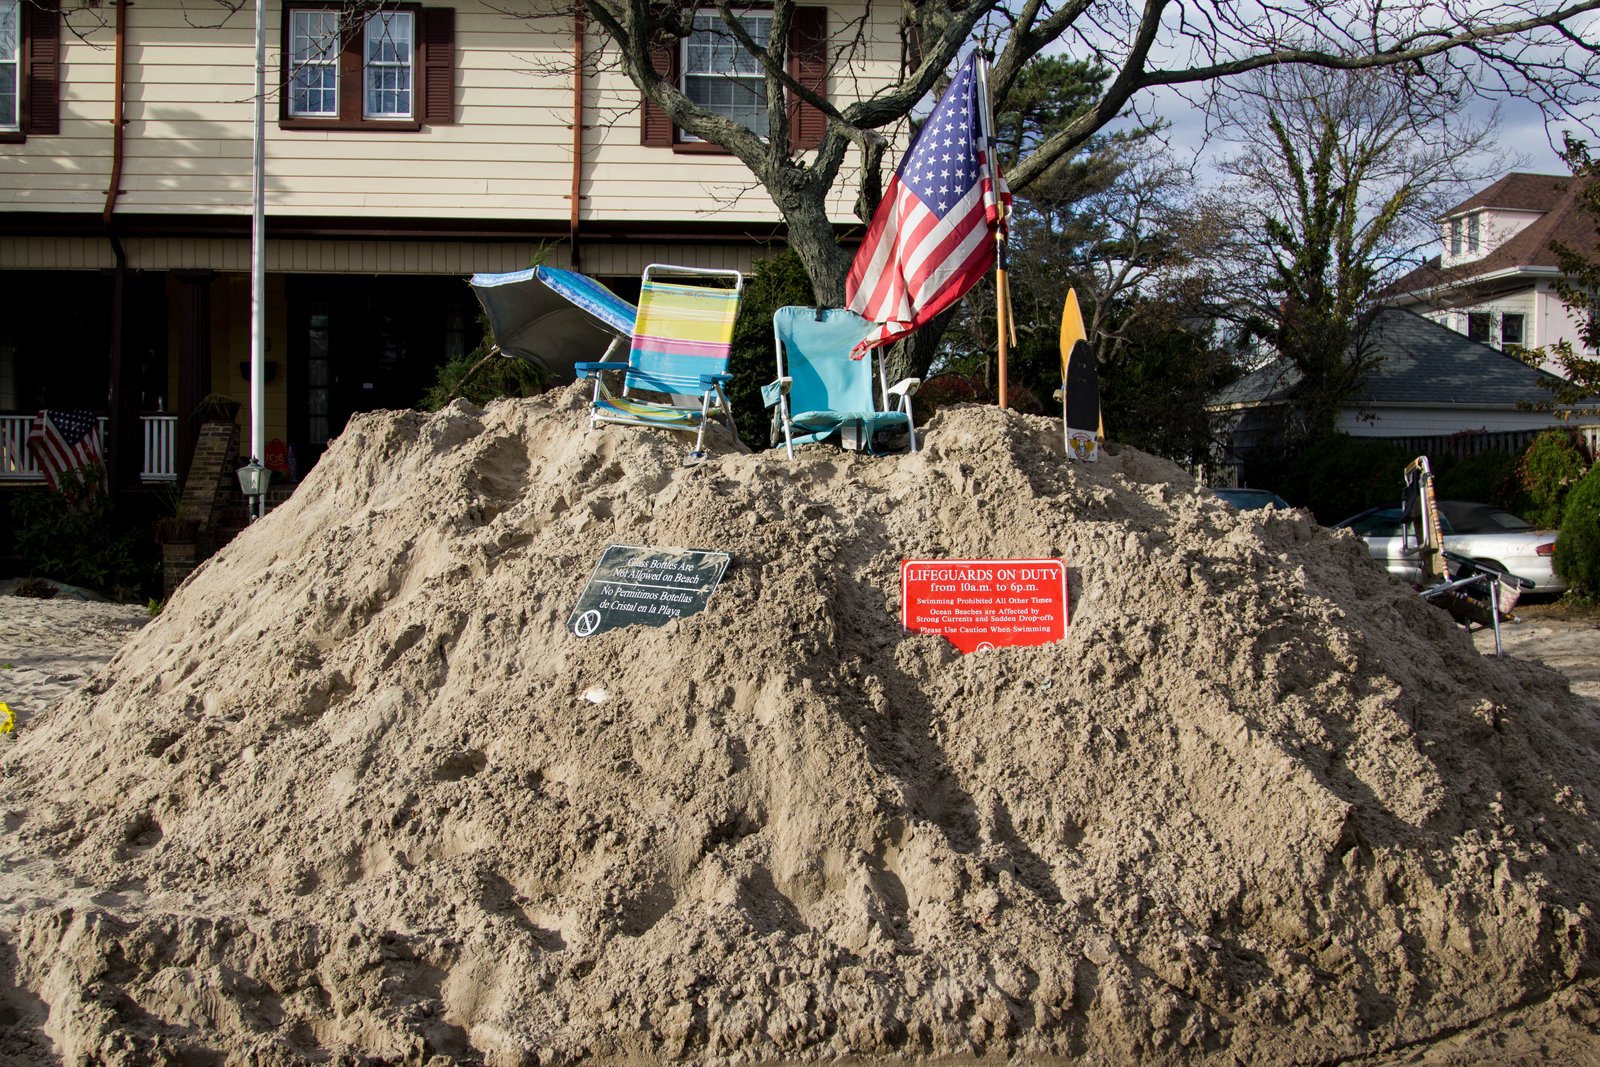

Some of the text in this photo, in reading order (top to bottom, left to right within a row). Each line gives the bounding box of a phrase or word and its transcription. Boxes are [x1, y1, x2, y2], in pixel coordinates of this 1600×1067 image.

[628, 558, 694, 571] Glass Bottles Are
[613, 568, 700, 584] Not Allowed on Beach
[909, 569, 1059, 581] LIFEGUARDS ON DUTY
[601, 585, 693, 603] No Permitimos Botellas
[930, 583, 1039, 593] from 10a.m. to 6p.m.
[599, 600, 681, 617] de Cristal en la Playa
[916, 616, 939, 624] Strong
[1019, 615, 1054, 623] Drop-offs
